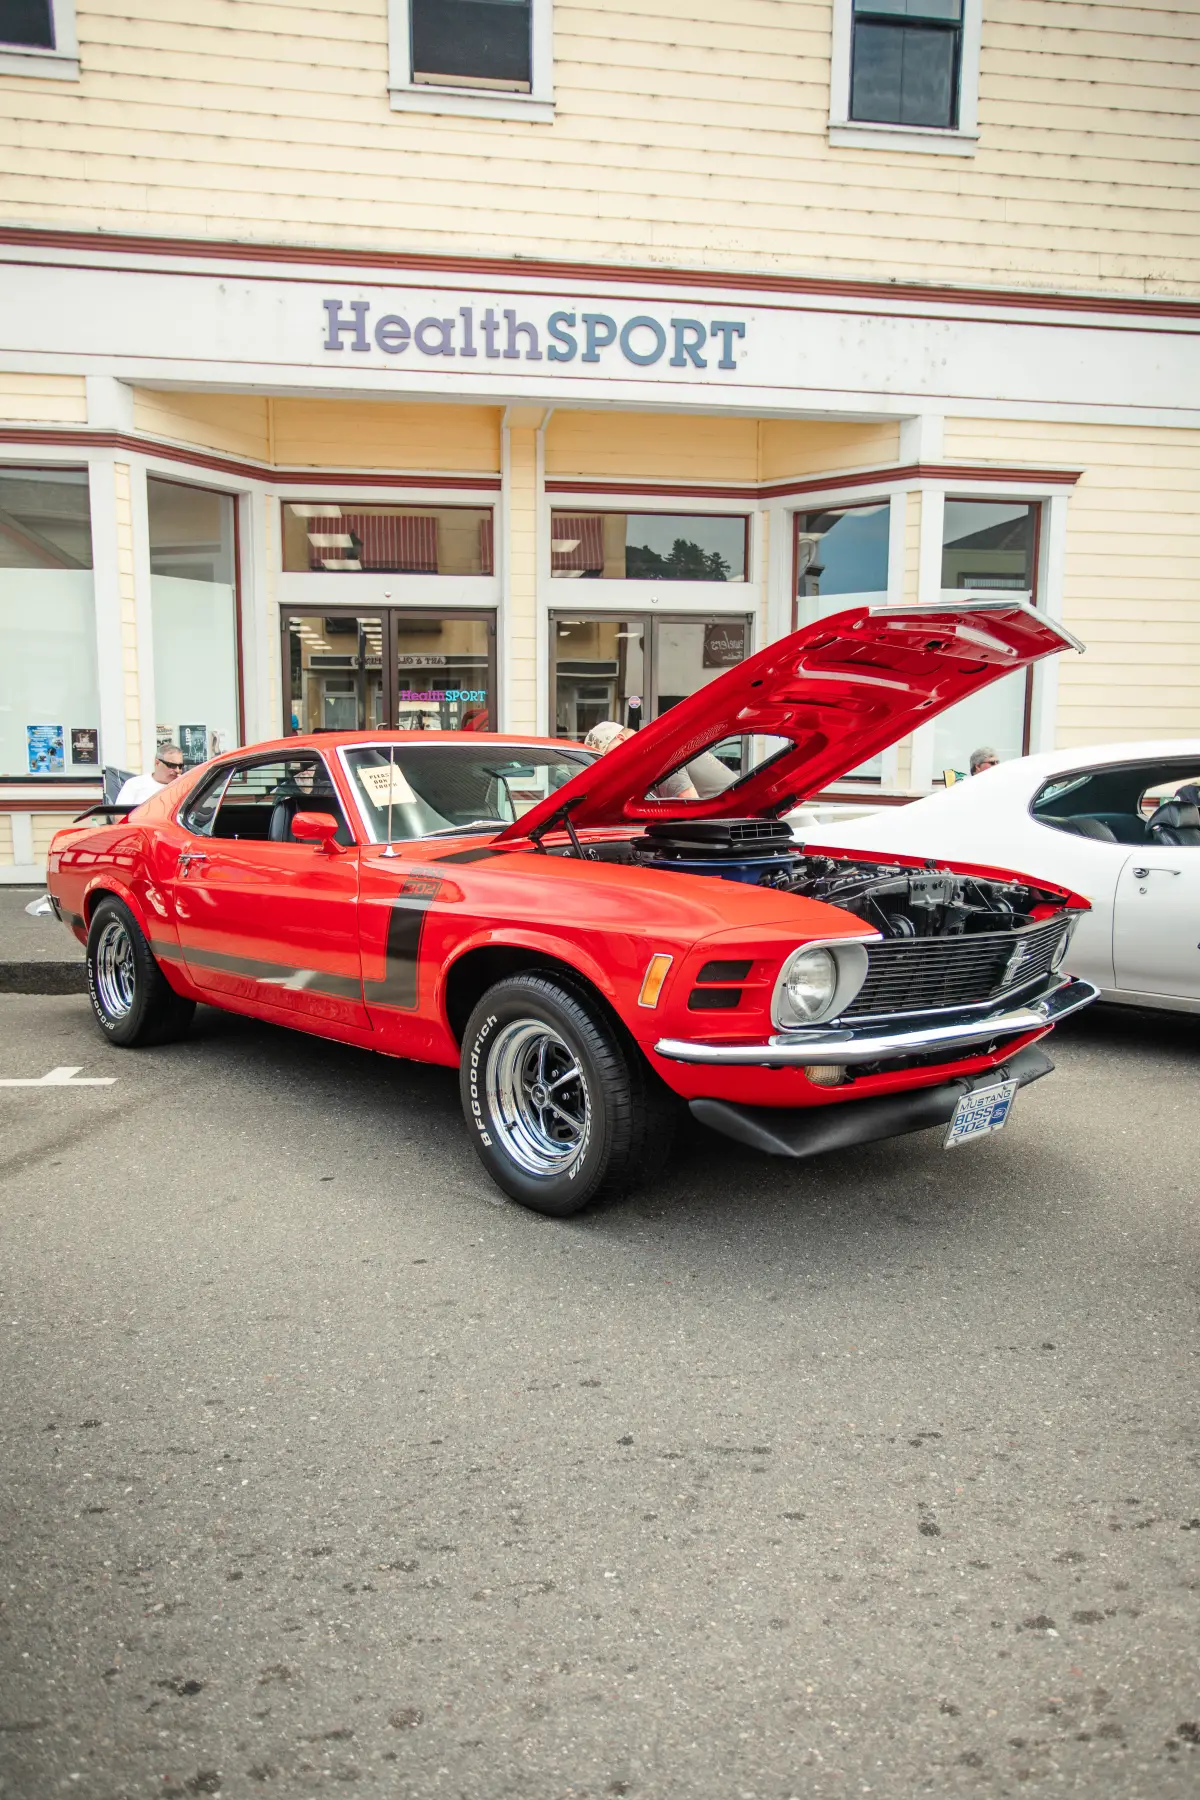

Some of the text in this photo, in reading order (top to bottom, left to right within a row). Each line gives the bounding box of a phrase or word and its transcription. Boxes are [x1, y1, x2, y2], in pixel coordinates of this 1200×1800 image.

[322, 299, 746, 370] HealthSPORT
[400, 690, 486, 702] HealthSPORT
[403, 883, 437, 895] 302
[468, 1014, 498, 1147] BFGoodrich
[960, 1090, 1011, 1112] MUSTANG
[954, 1105, 994, 1127] BOSS
[952, 1119, 987, 1137] 302
